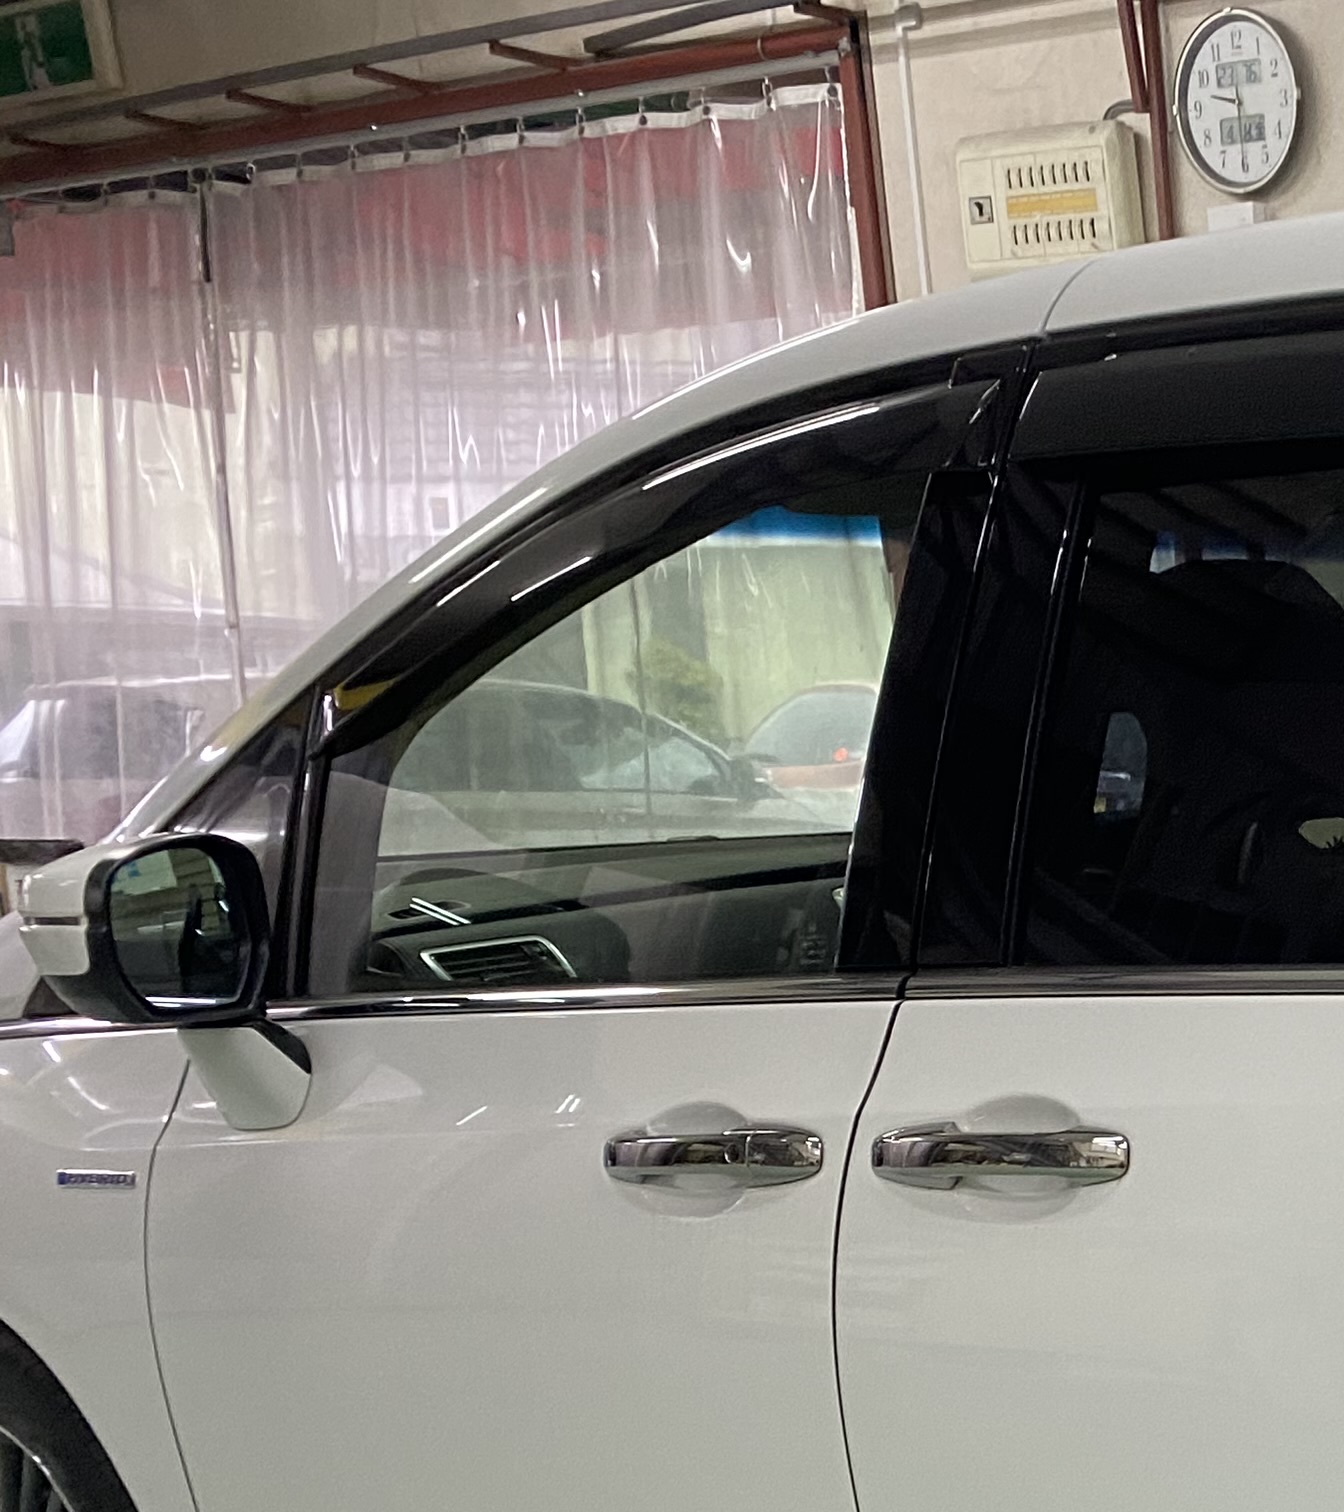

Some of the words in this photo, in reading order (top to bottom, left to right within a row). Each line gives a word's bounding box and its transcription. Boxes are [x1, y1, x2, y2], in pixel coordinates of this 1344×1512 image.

[1230, 30, 1242, 50] 12
[1211, 43, 1221, 62] 11
[1270, 59, 1278, 78] 2
[1198, 69, 1210, 88] 10
[1280, 90, 1288, 107] 3
[1194, 100, 1202, 118] 9
[1203, 129, 1212, 147] 8
[1275, 120, 1282, 139] 4
[1219, 150, 1226, 169] 7
[1261, 144, 1269, 164] 5
